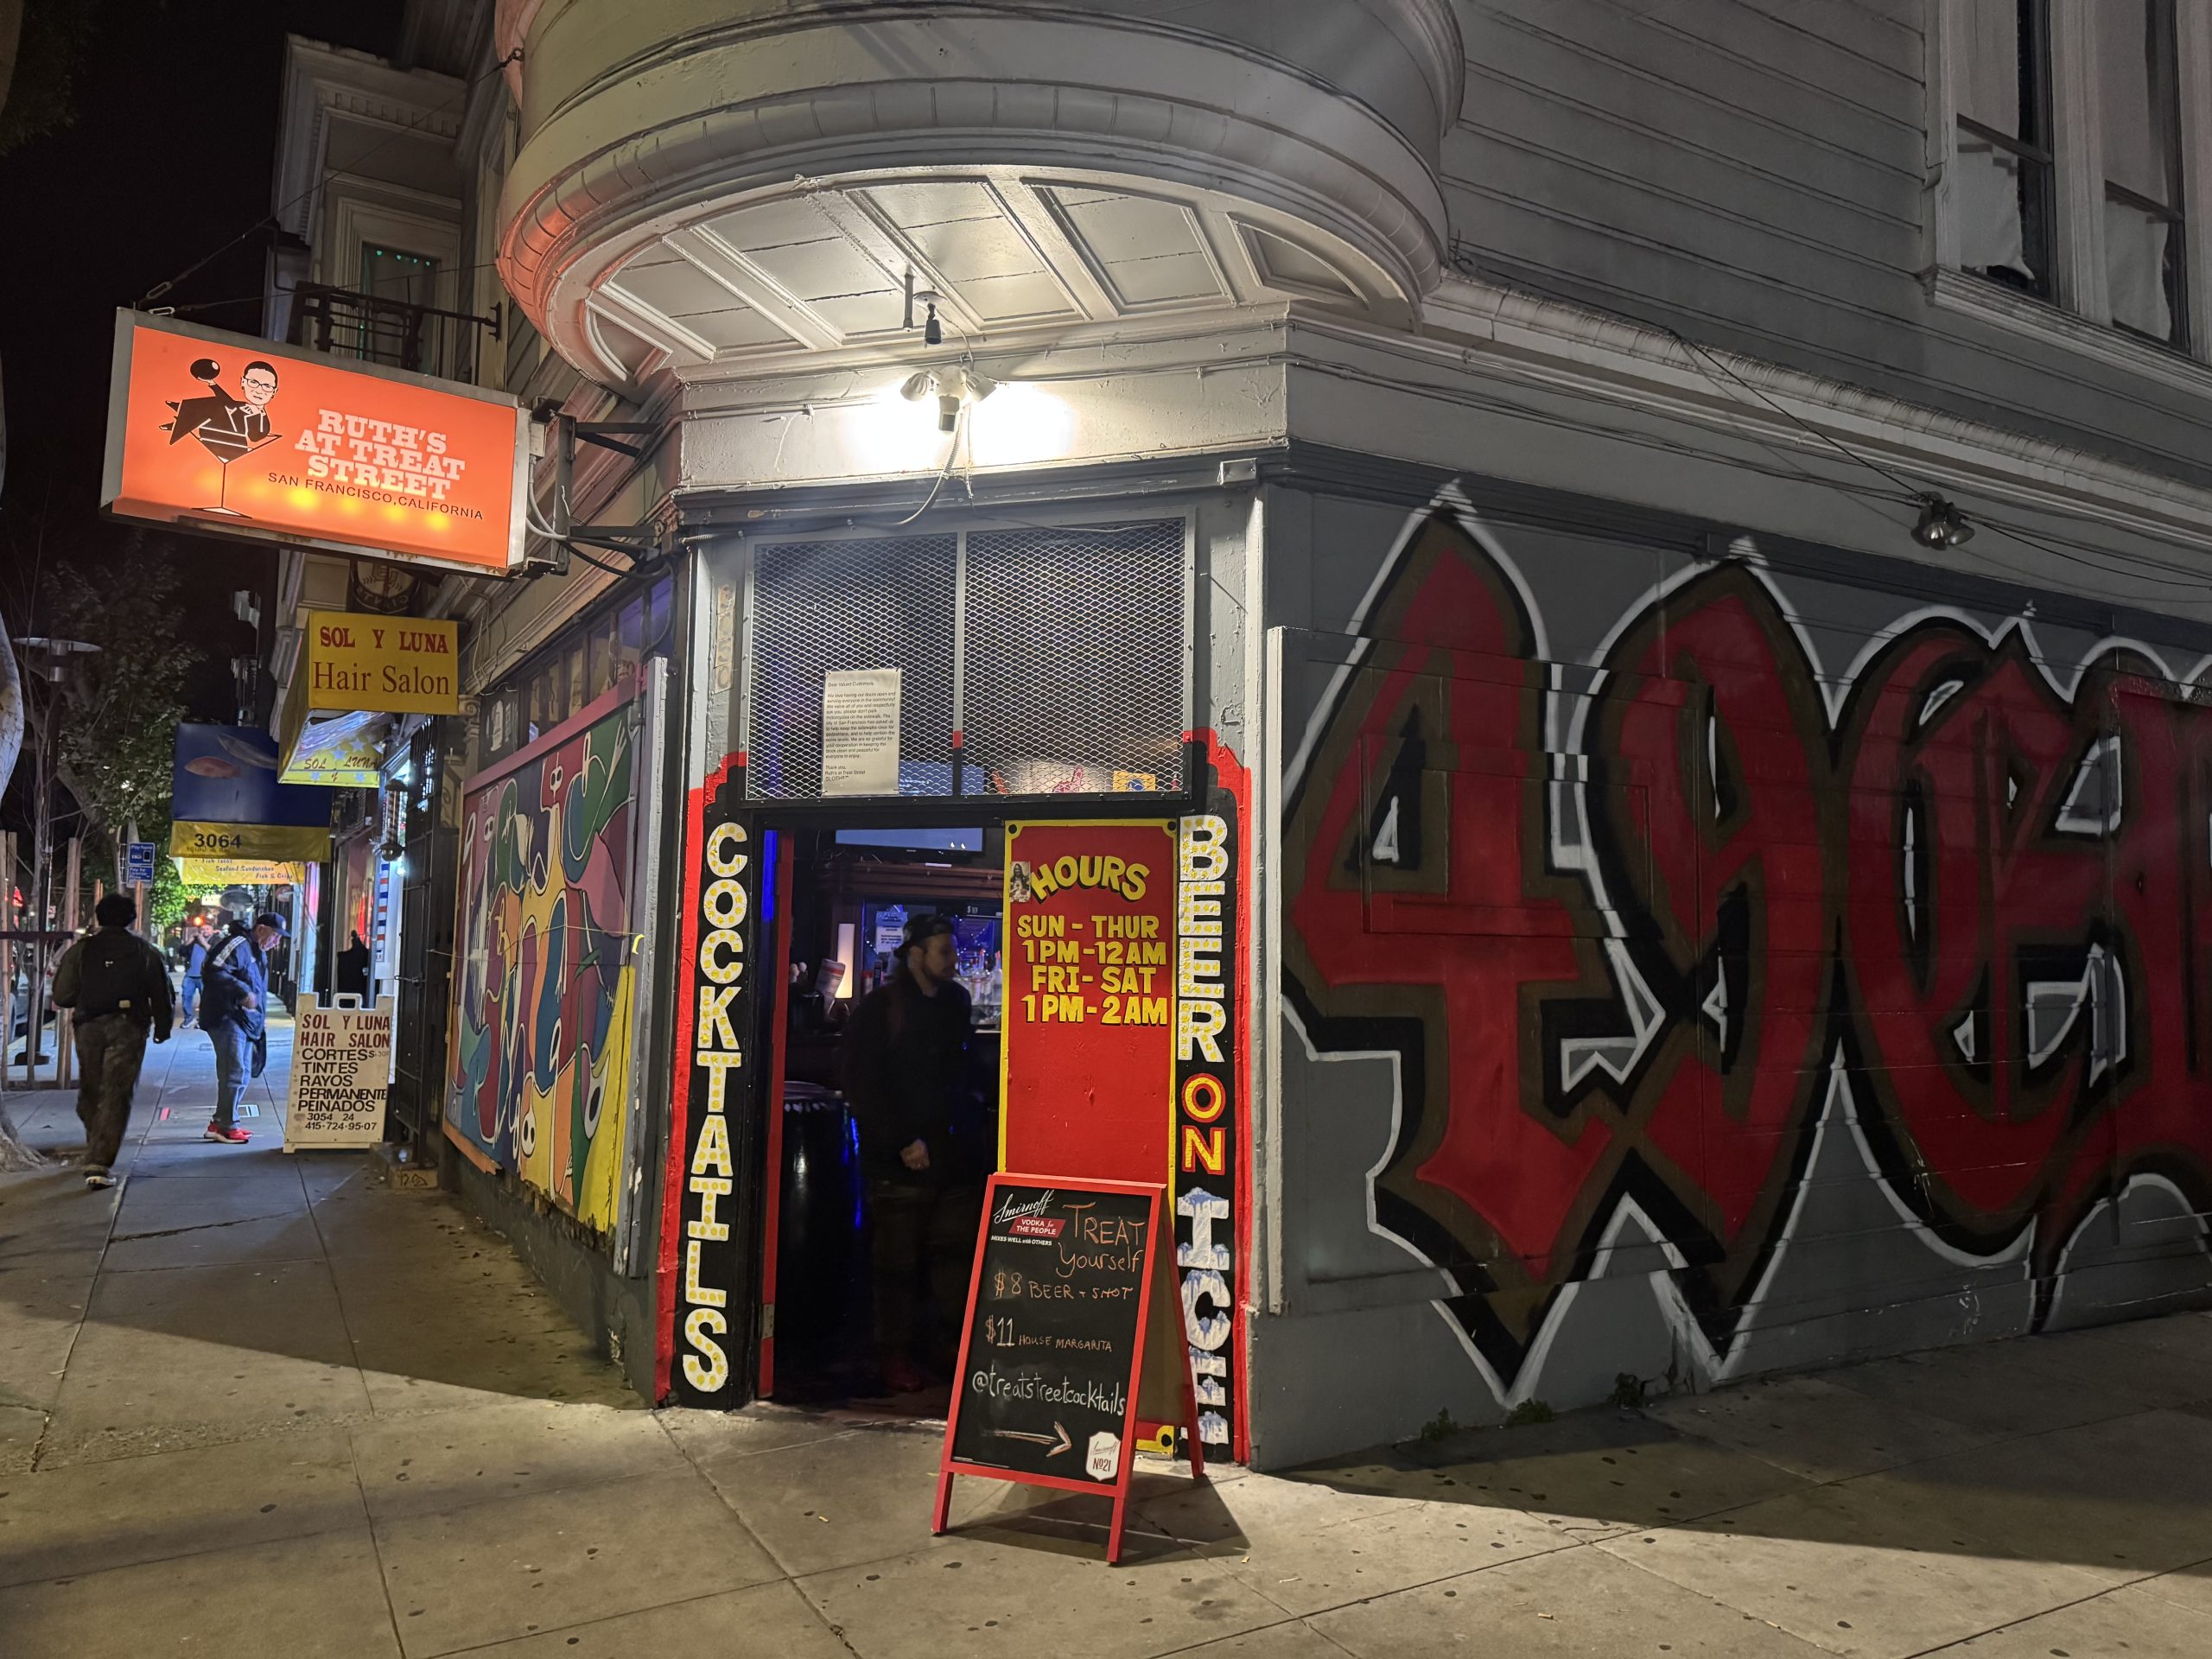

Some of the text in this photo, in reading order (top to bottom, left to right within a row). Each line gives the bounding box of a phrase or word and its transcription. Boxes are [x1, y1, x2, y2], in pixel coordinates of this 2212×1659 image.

[318, 409, 447, 454] RUTH'S
[295, 429, 465, 480] AT TREAT
[269, 472, 299, 486] SAN
[308, 454, 450, 500] STREET
[320, 626, 449, 653] SOL Y LUNA
[314, 662, 449, 695] Hair Salon
[304, 758, 327, 769] SOL
[194, 833, 241, 849] 3064
[1031, 855, 1150, 901] HOURS
[1017, 914, 1065, 938] SUN
[1090, 915, 1160, 939] THUR
[302, 1014, 390, 1030] SOL Y LUNA
[301, 1032, 390, 1048] HAIR SALON
[300, 1075, 353, 1087] RAYOS
[302, 1062, 359, 1074] TINTES
[297, 1100, 375, 1112] PEINADOS
[299, 1089, 387, 1100] PERMANENTE
[682, 822, 747, 1394] COCKTAILS
[1177, 814, 1231, 1444] BEER ON ICE
[993, 1189, 1054, 1224] Smirnoff
[1062, 1201, 1145, 1246] TREAT
[1028, 1281, 1074, 1299] BEER
[1092, 1287, 1134, 1300] SHOT
[985, 1315, 1112, 1352] $11 HOUSE MARGARITA
